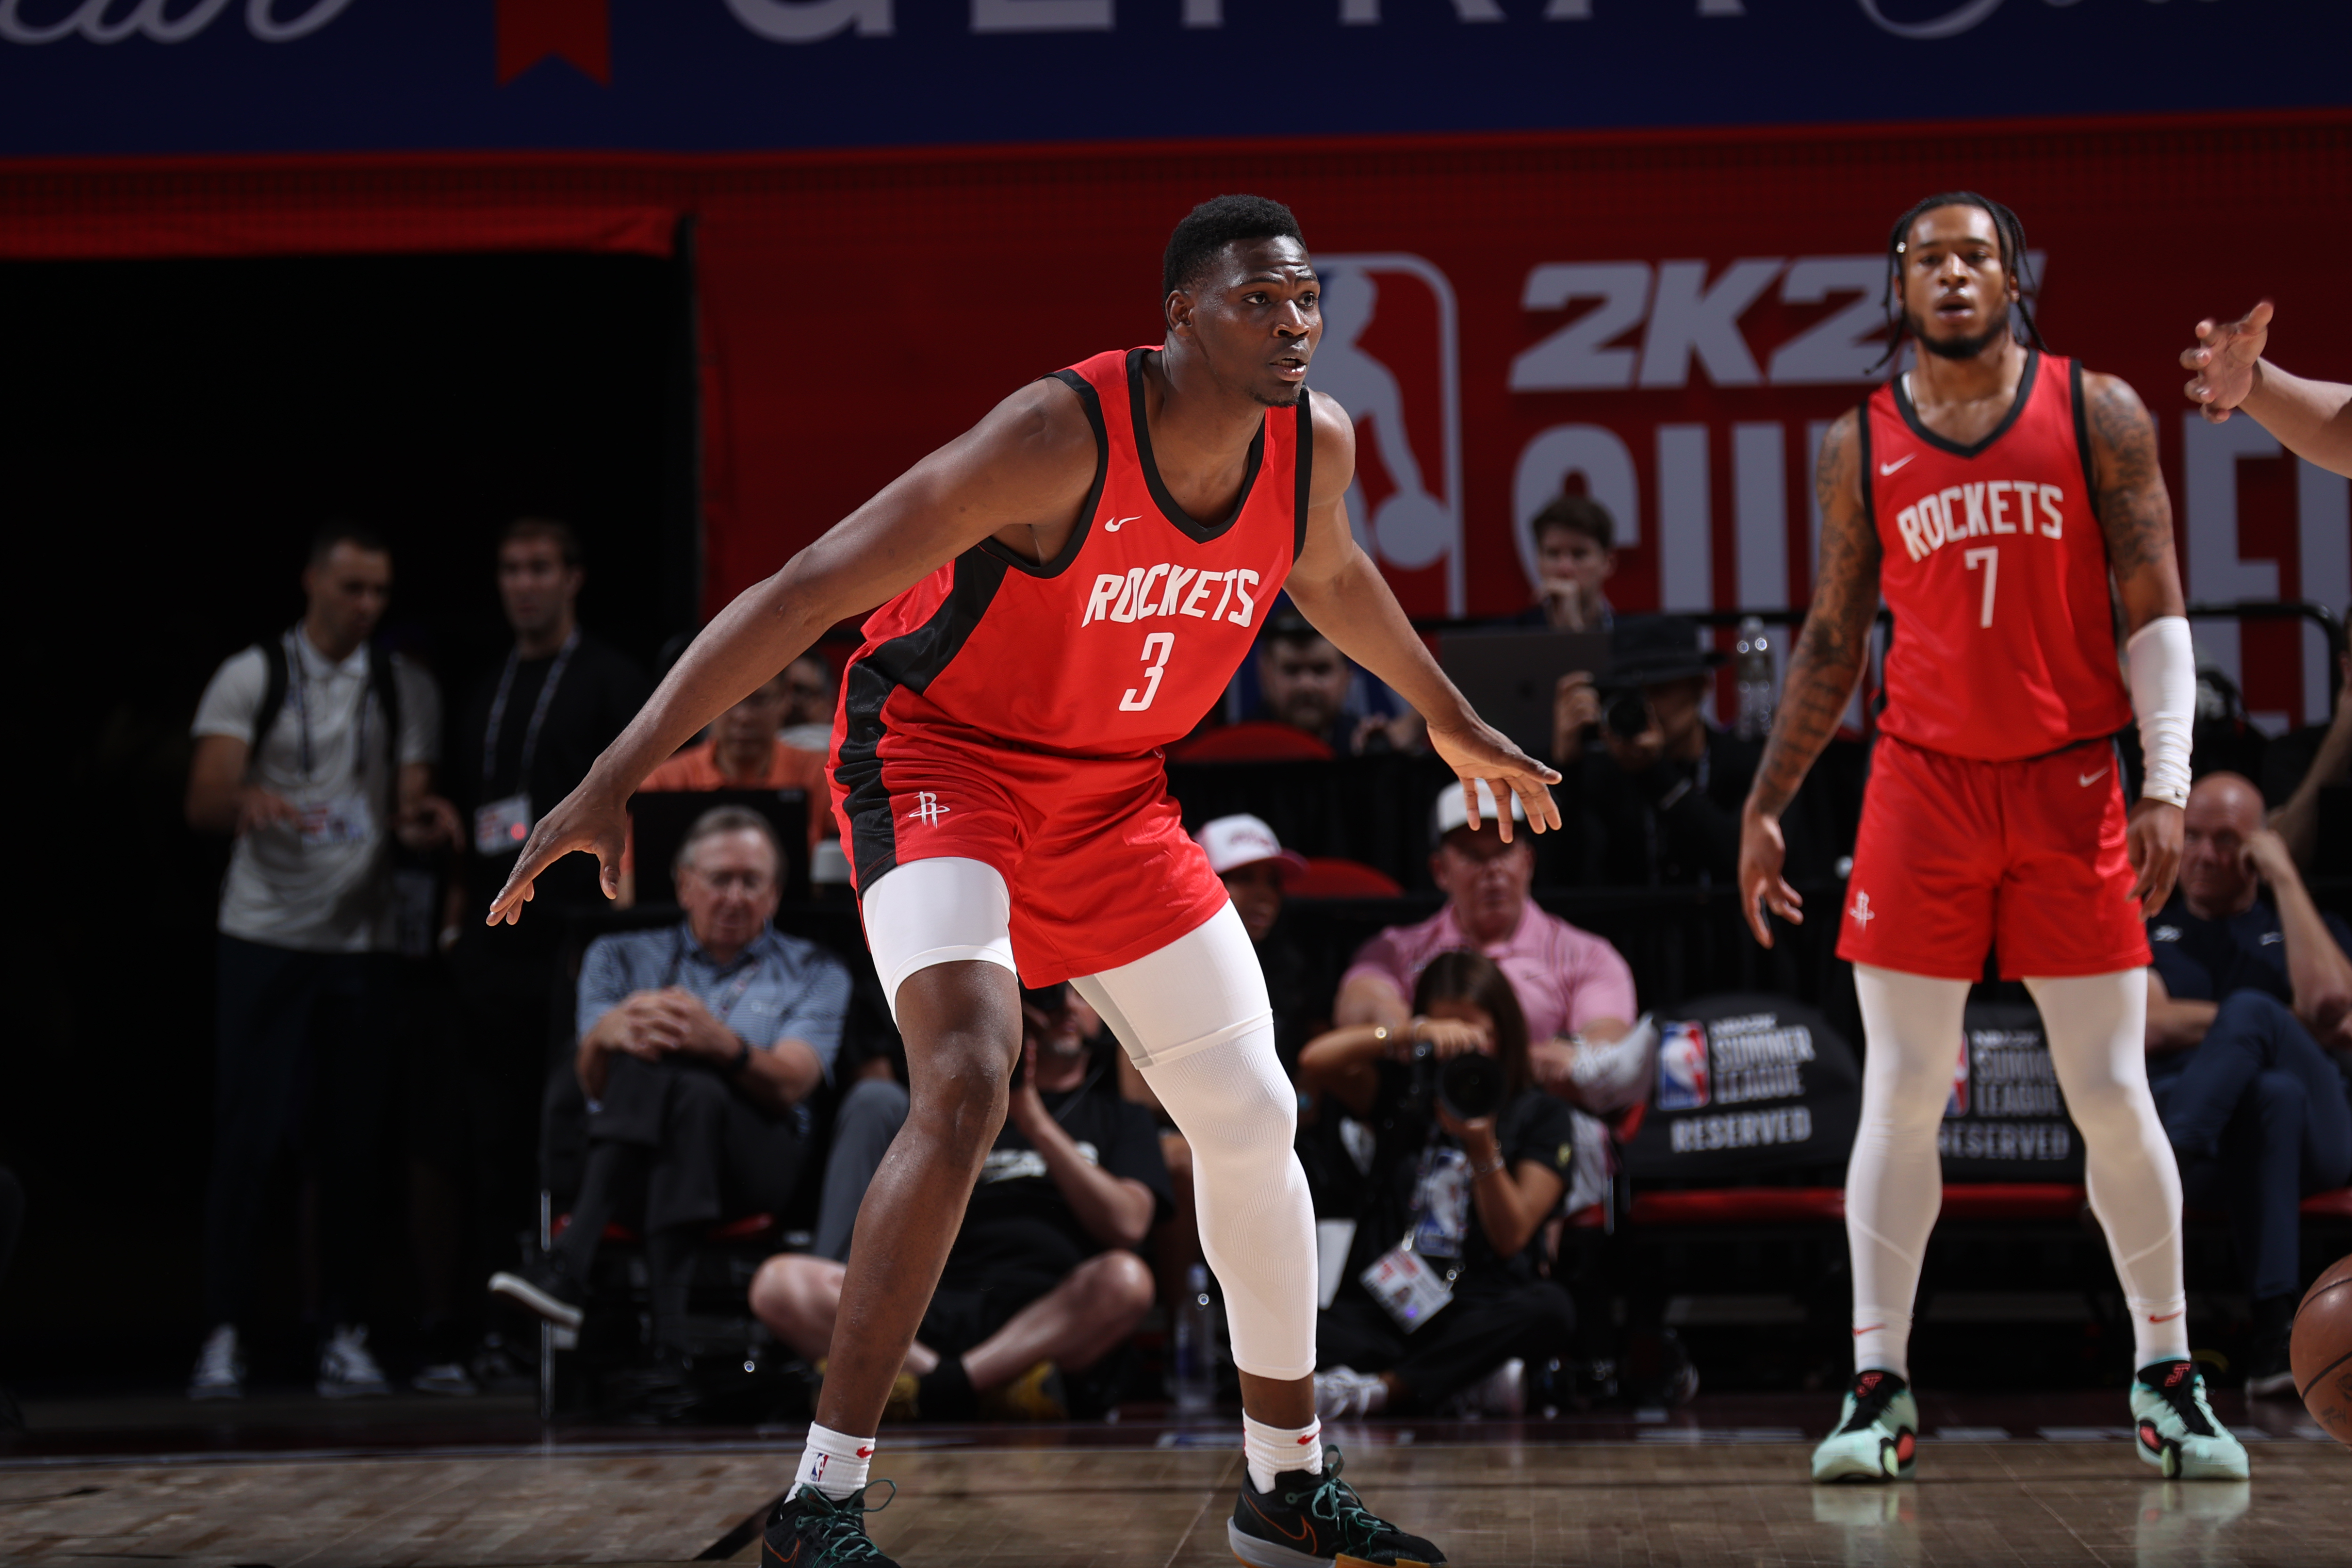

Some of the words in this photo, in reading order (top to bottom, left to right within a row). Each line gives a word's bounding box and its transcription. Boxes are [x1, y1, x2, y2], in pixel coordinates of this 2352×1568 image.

[1506, 248, 2049, 393] 2K2
[1896, 479, 2064, 563] ROCKETS
[1081, 562, 1260, 628] ROCKETS
[1964, 546, 1999, 629] 7
[1118, 632, 1175, 712] 3
[1712, 1024, 1816, 1073] SUMMER
[1714, 1063, 1806, 1105] LEAGUE
[1669, 1104, 1813, 1154] RESERVED
